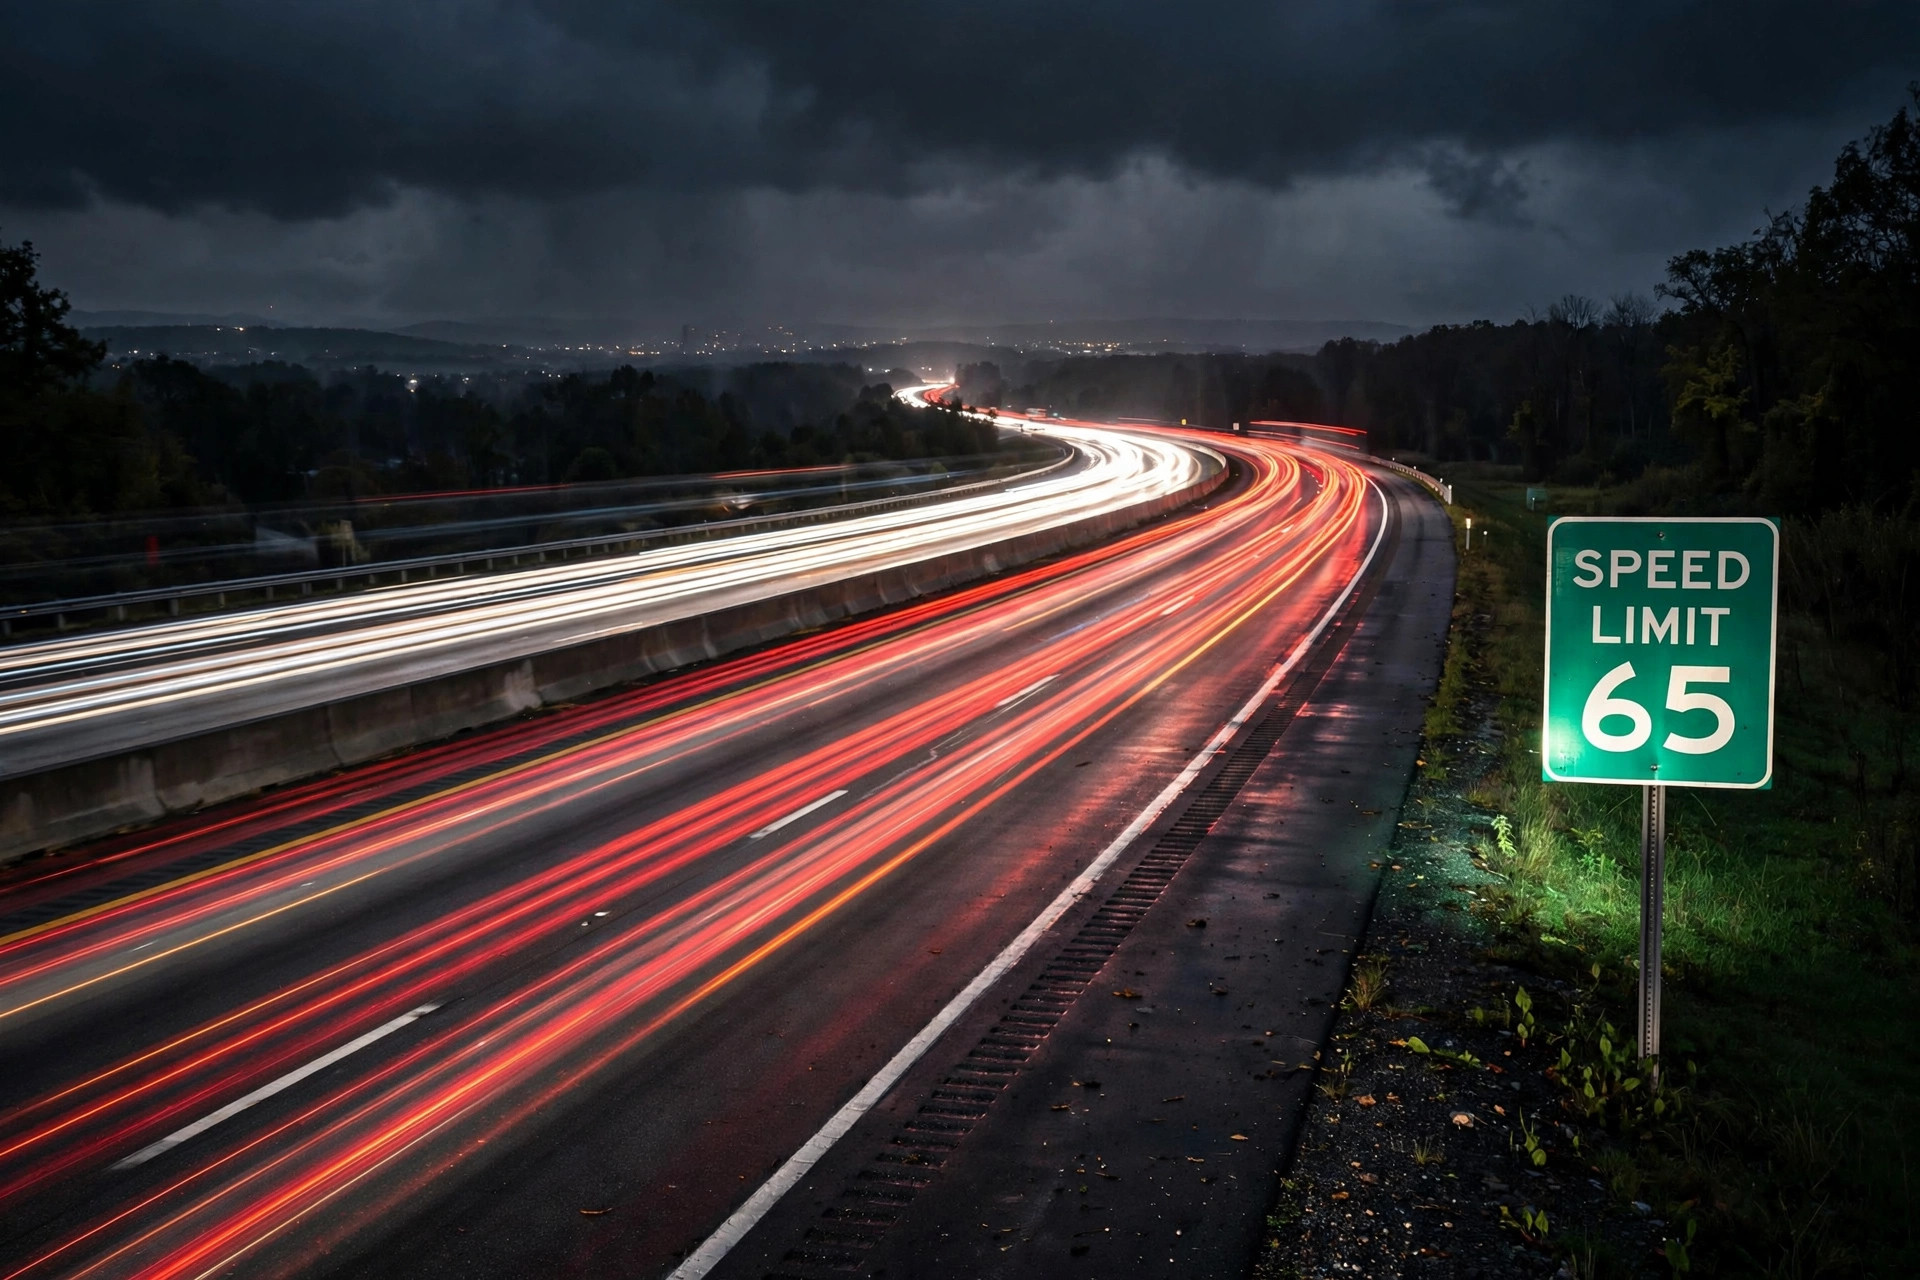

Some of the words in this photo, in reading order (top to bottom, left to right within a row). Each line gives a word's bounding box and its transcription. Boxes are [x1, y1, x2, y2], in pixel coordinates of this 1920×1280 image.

[1573, 550, 1750, 590] SPEED
[1592, 606, 1730, 646] LIMIT
[1581, 661, 1735, 755] 65
